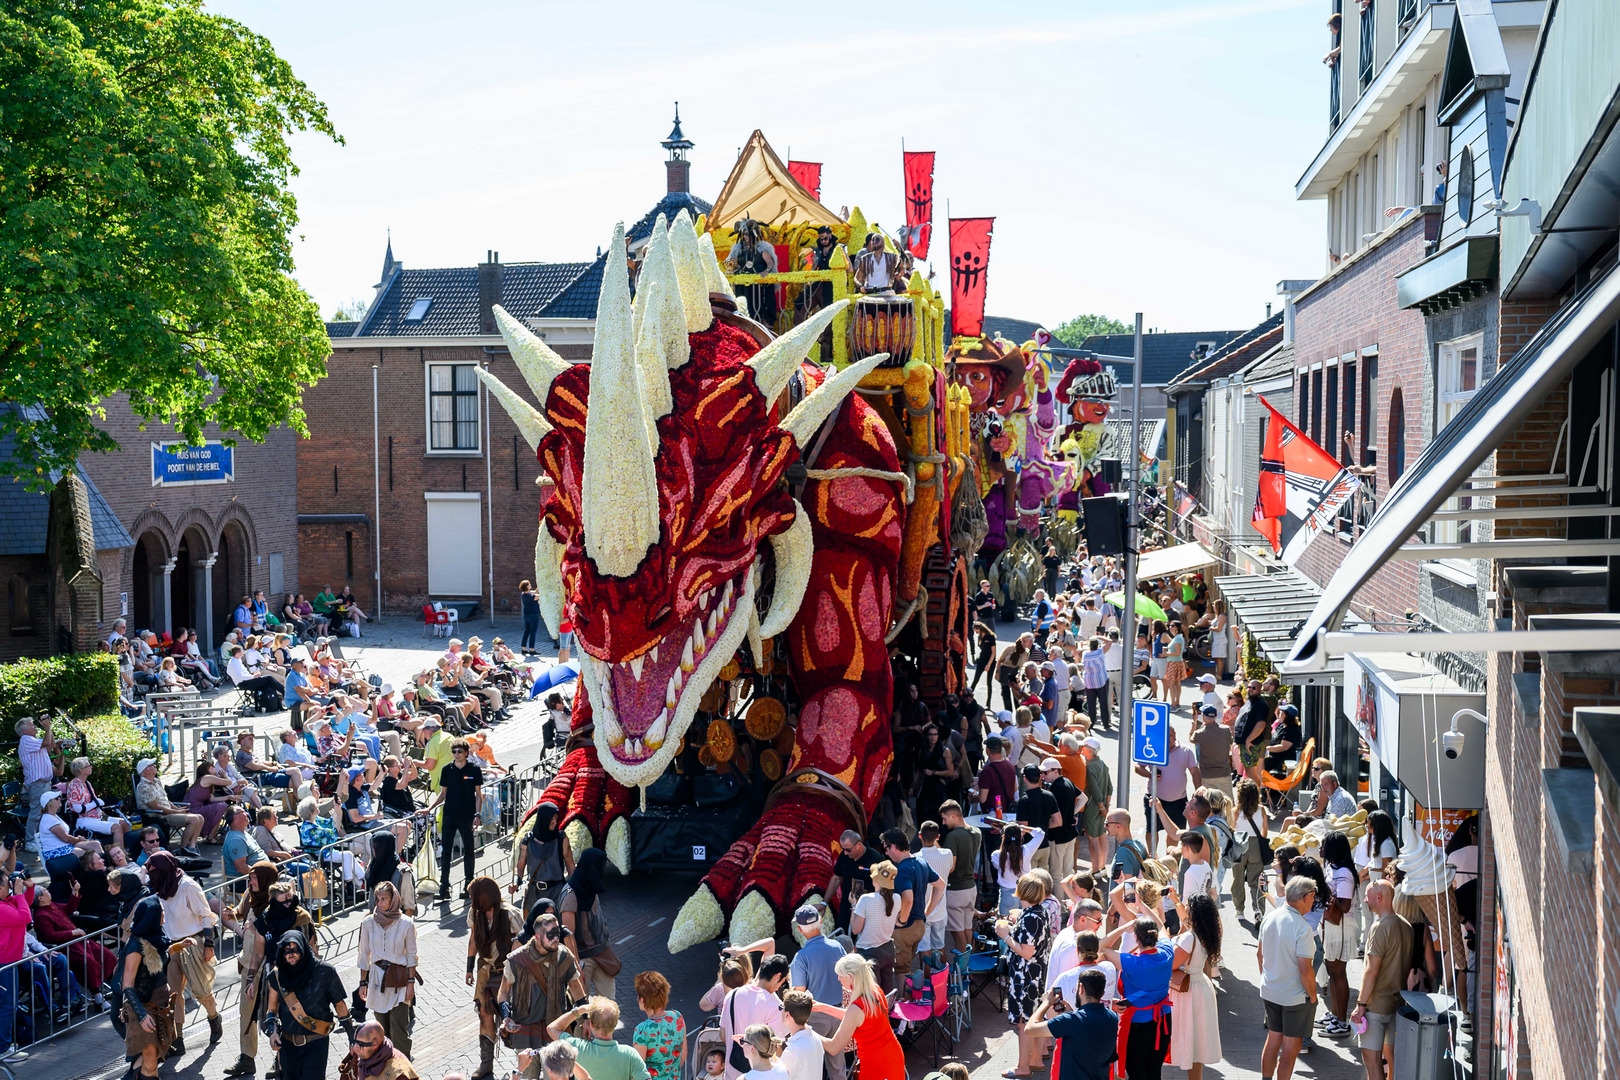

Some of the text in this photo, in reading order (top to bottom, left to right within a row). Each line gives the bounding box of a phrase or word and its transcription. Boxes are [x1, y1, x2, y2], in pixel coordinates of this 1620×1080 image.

[176, 450, 212, 460] HUIS VAN GOD
[167, 462, 220, 473] POORT VAN DE HEMEL
[1141, 706, 1160, 736] P
[693, 847, 704, 855] 02
